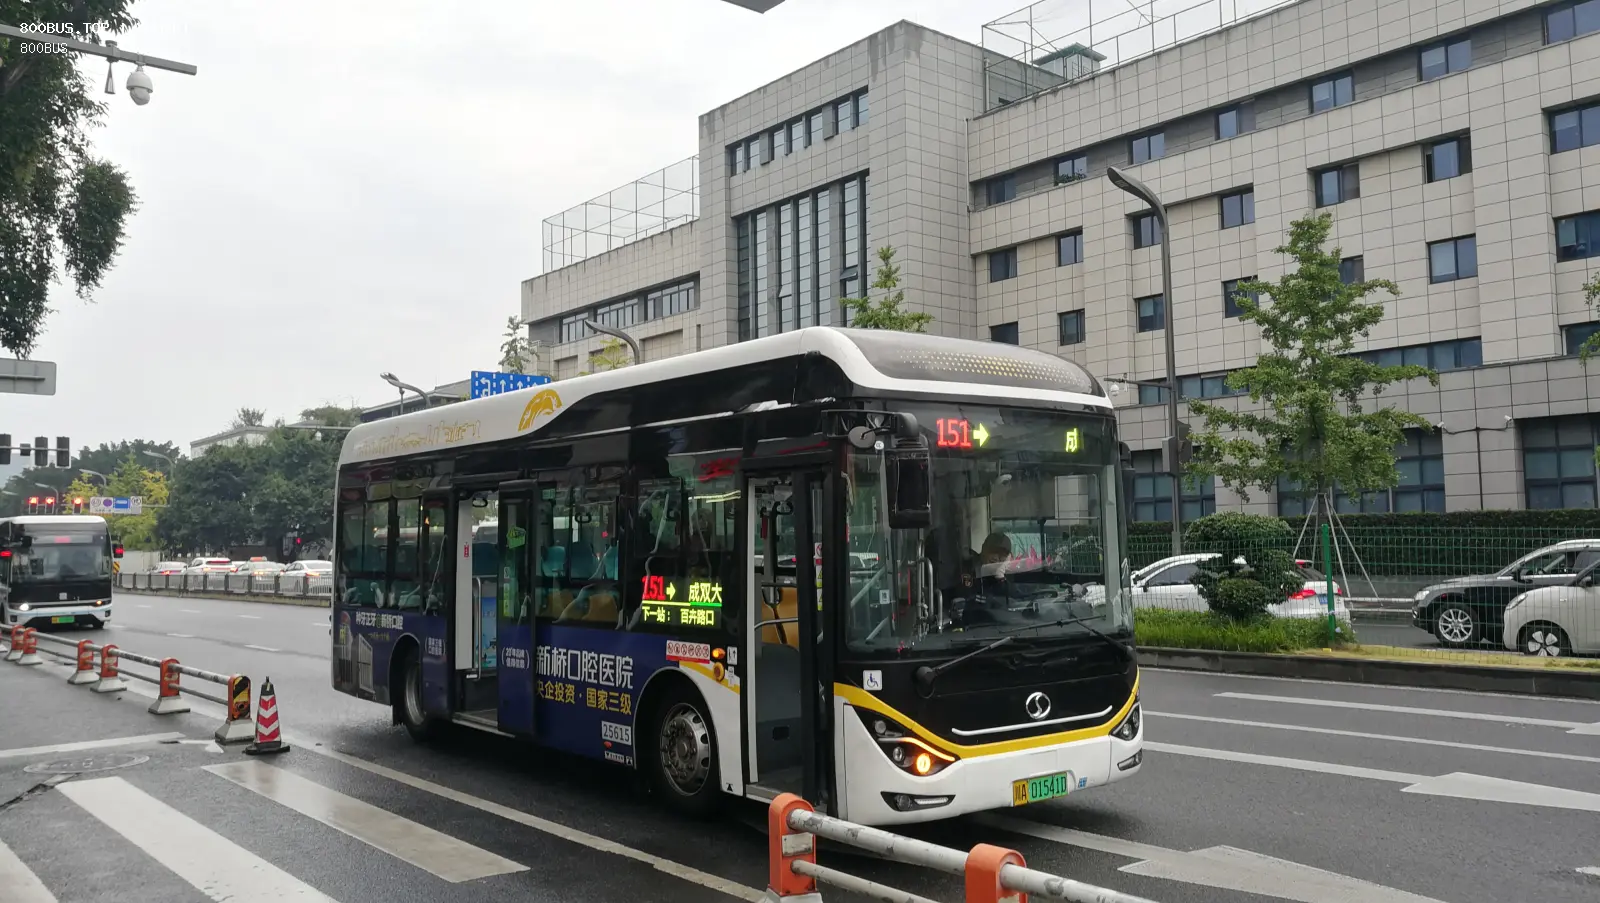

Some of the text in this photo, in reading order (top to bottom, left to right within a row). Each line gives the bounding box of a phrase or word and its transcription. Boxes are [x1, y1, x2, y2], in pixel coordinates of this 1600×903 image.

[936, 418, 972, 447] 151
[1065, 428, 1078, 453] 成
[641, 575, 666, 600] 151
[688, 581, 723, 604] 成双大
[680, 608, 715, 626] 百卉路口
[536, 645, 634, 690] 新桥口腔医院
[603, 723, 630, 743] 25615
